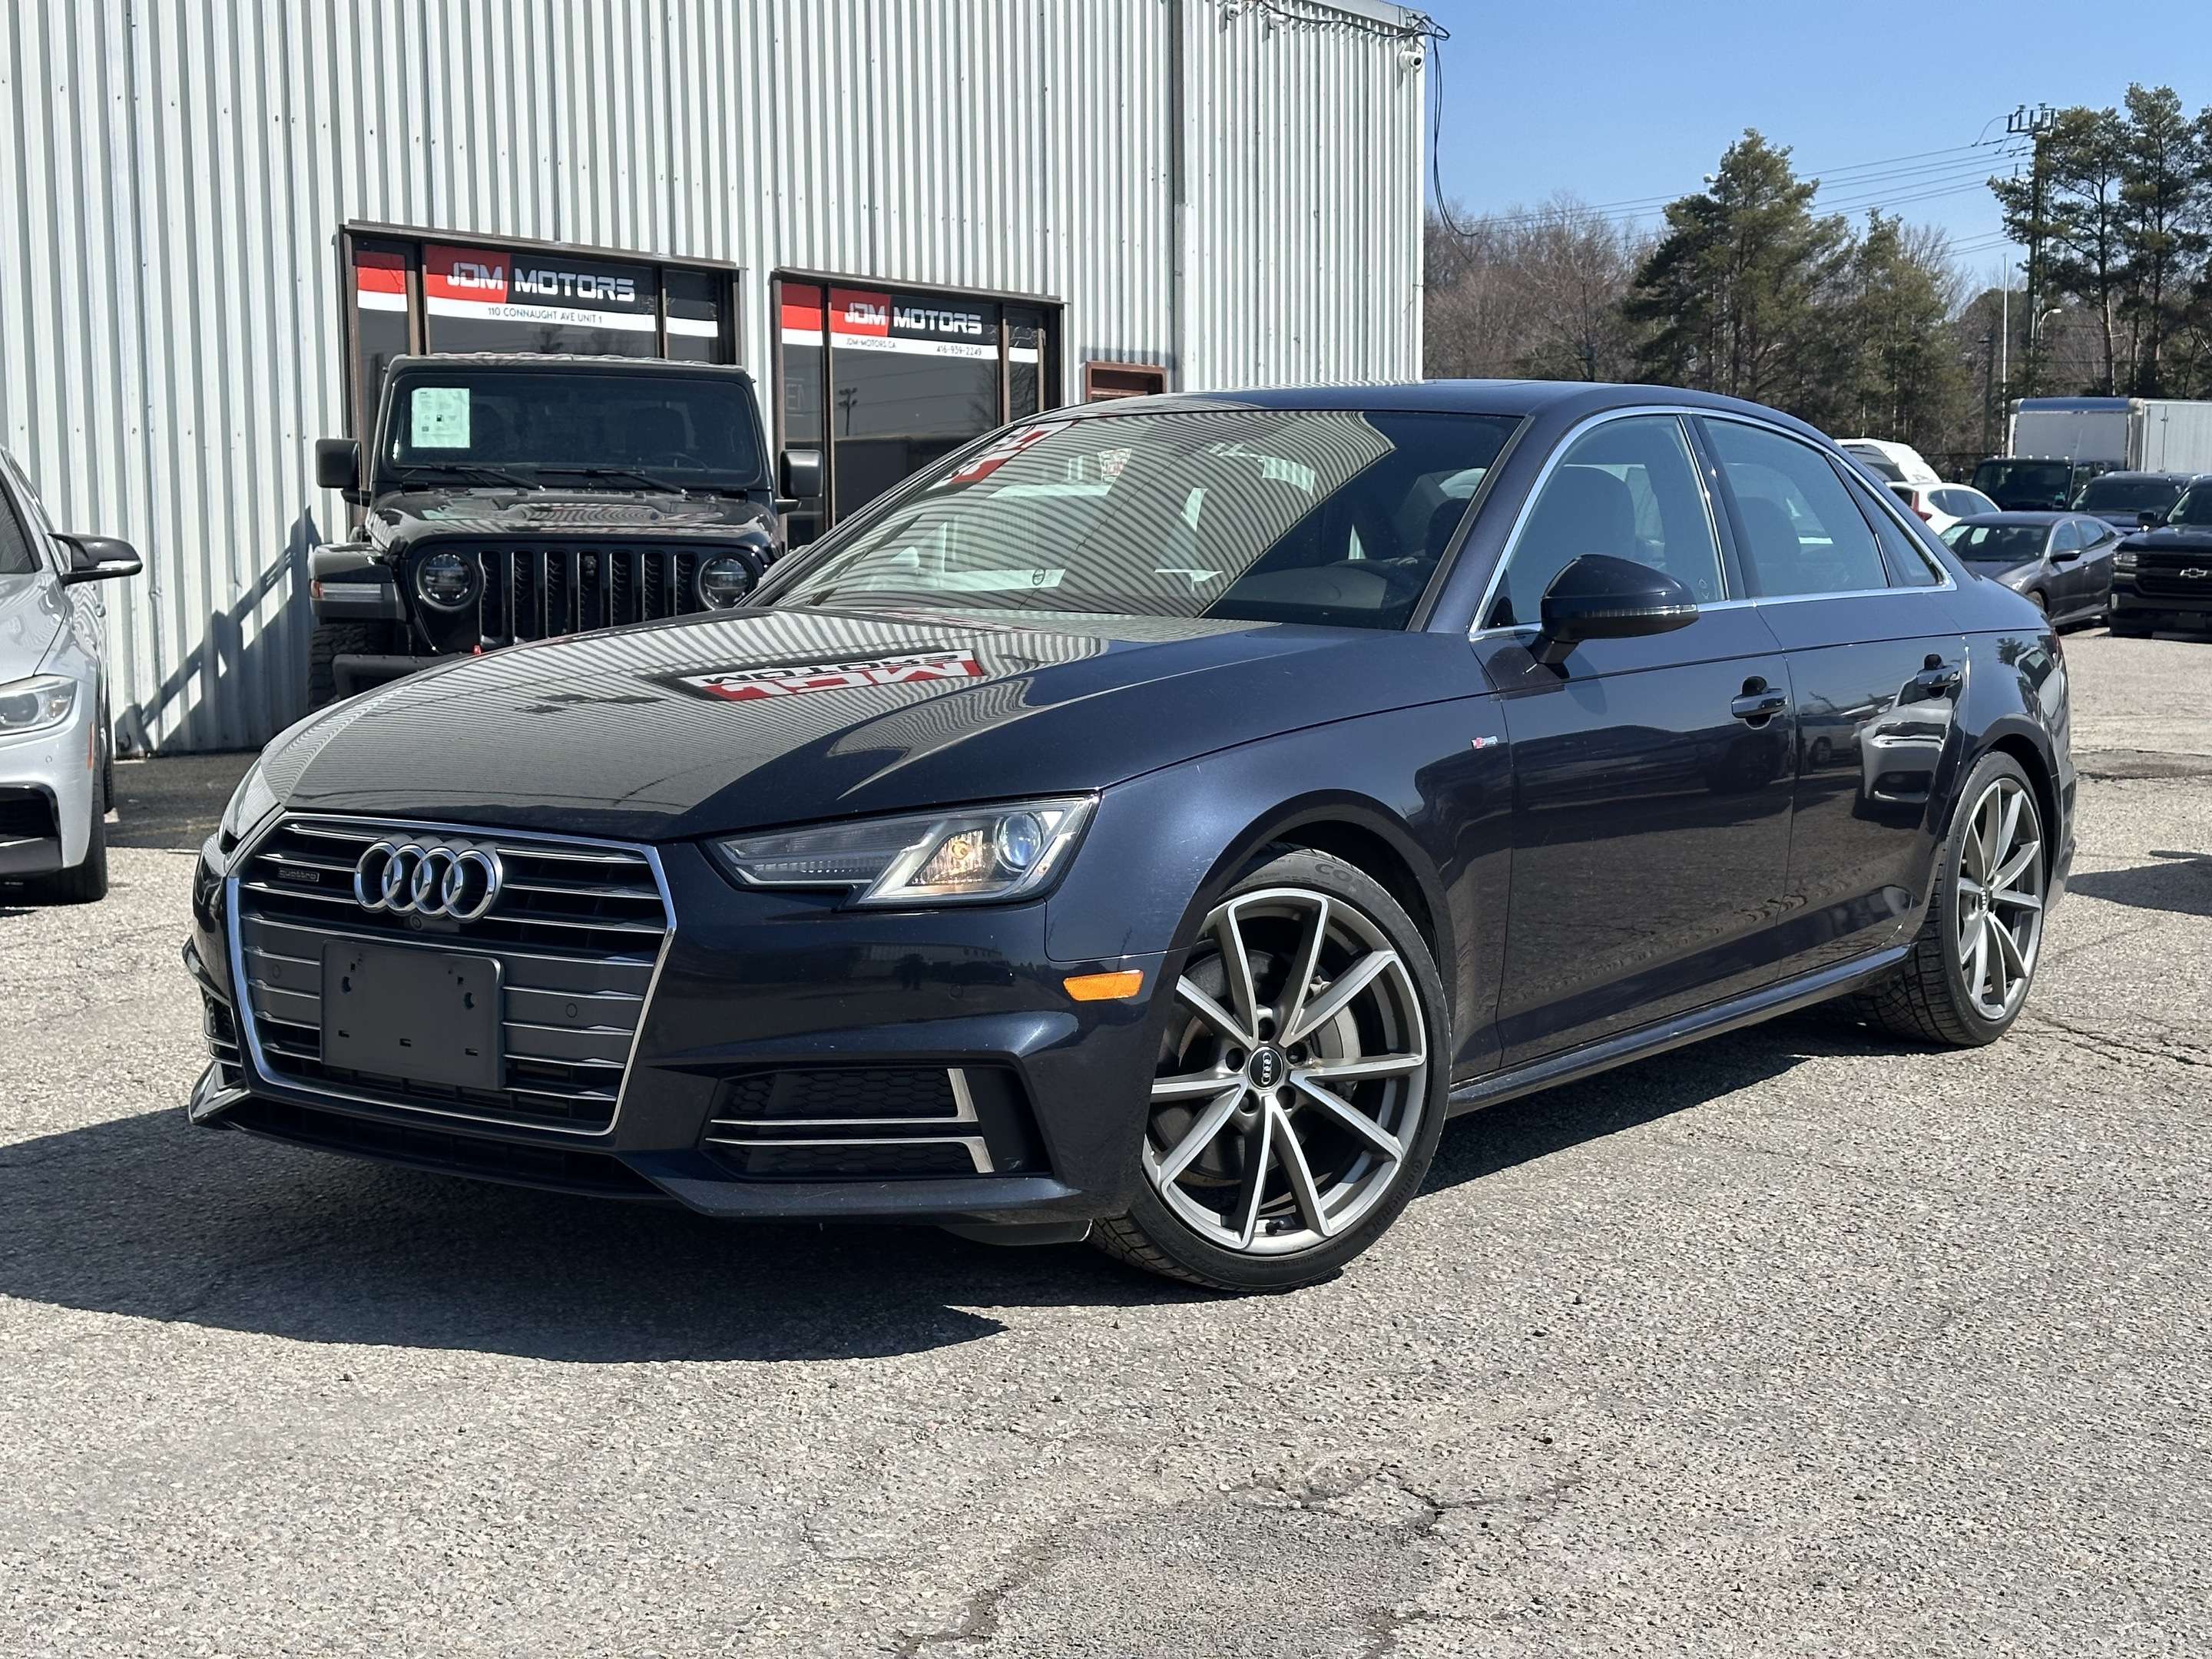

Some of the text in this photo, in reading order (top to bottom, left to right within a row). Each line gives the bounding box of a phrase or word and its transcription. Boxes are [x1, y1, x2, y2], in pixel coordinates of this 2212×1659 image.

[446, 262, 636, 303] JDM MOTORS
[488, 307, 501, 316] 110
[503, 307, 558, 320] CONNAUGHT
[561, 312, 575, 322] AVE
[578, 313, 597, 323] UNIT
[844, 302, 982, 335] JDM MOTORS
